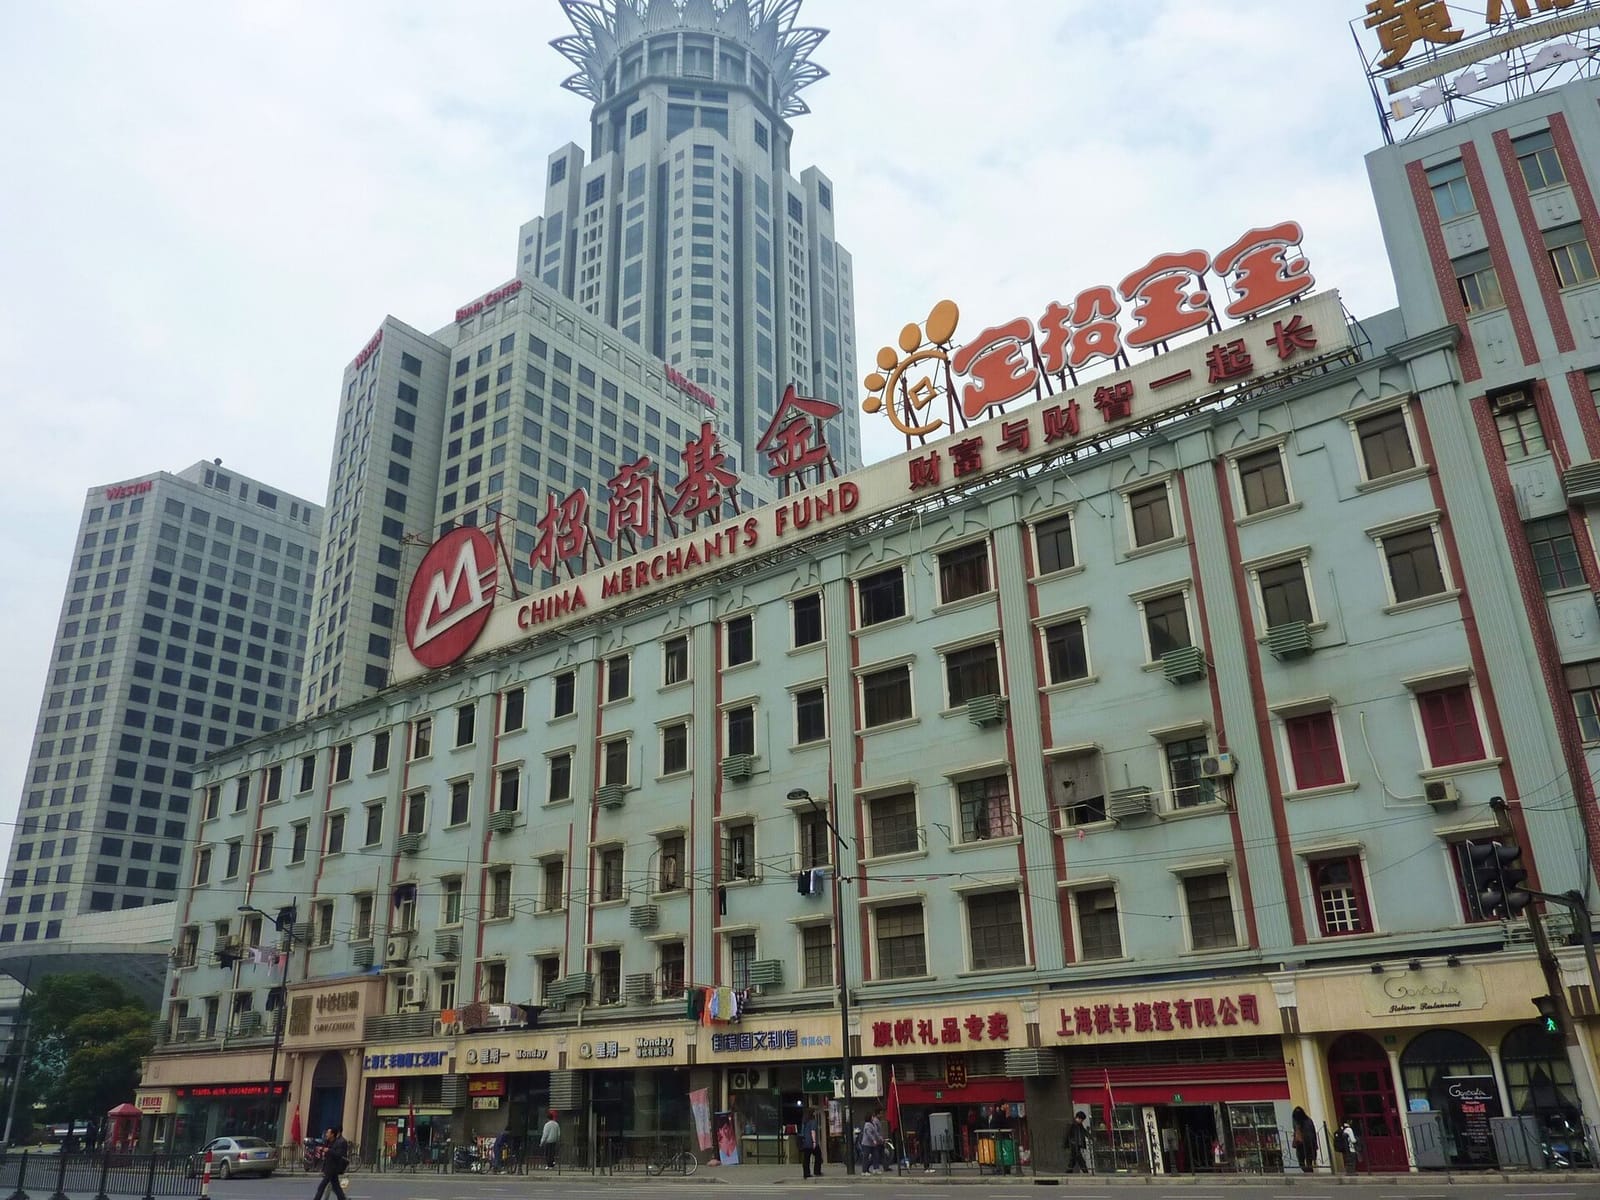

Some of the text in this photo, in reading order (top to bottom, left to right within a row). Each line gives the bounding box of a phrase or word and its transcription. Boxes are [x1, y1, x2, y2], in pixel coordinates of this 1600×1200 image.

[663, 363, 717, 410] WESTIN
[908, 315, 1317, 491] 财富与财智一起长
[106, 481, 153, 500] WESTIN
[529, 384, 842, 571] 招商基金
[517, 481, 860, 629] CHINA MERCHANTS FUND
[636, 1037, 674, 1049] Monday
[872, 1012, 1009, 1048] 旗帜礼品专卖
[515, 1049, 548, 1060] Monday
[595, 1041, 630, 1059] 星期一
